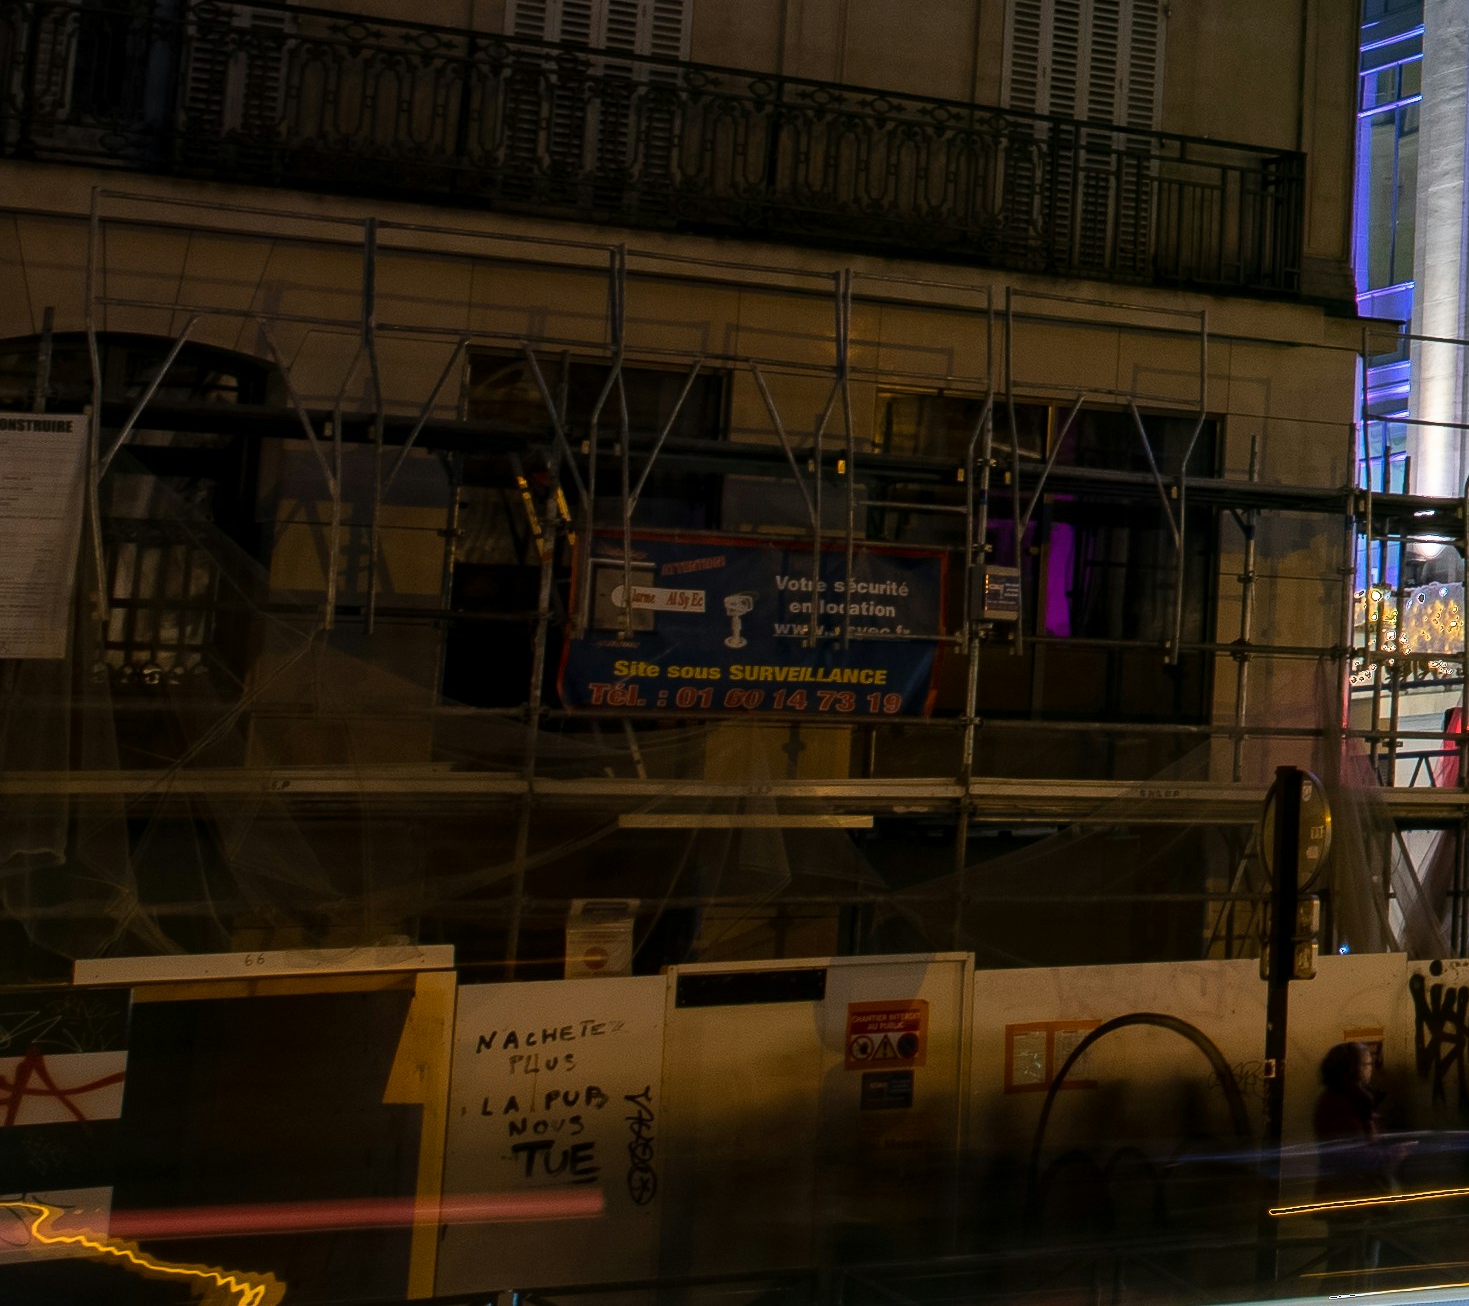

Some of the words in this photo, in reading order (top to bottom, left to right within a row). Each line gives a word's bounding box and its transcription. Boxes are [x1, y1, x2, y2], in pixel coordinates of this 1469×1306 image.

[0, 418, 73, 433] ONSTRUIRE
[613, 660, 660, 678] Site
[667, 665, 721, 681] sous
[729, 664, 888, 686] SURVEILLANCE
[675, 687, 713, 708] 01
[773, 689, 808, 711] 14
[818, 691, 856, 712] 73
[867, 692, 903, 714] 19
[481, 1095, 520, 1116] LA
[545, 1085, 609, 1110] PUB
[508, 1114, 584, 1138] NOUS
[511, 1139, 601, 1179] TUE
